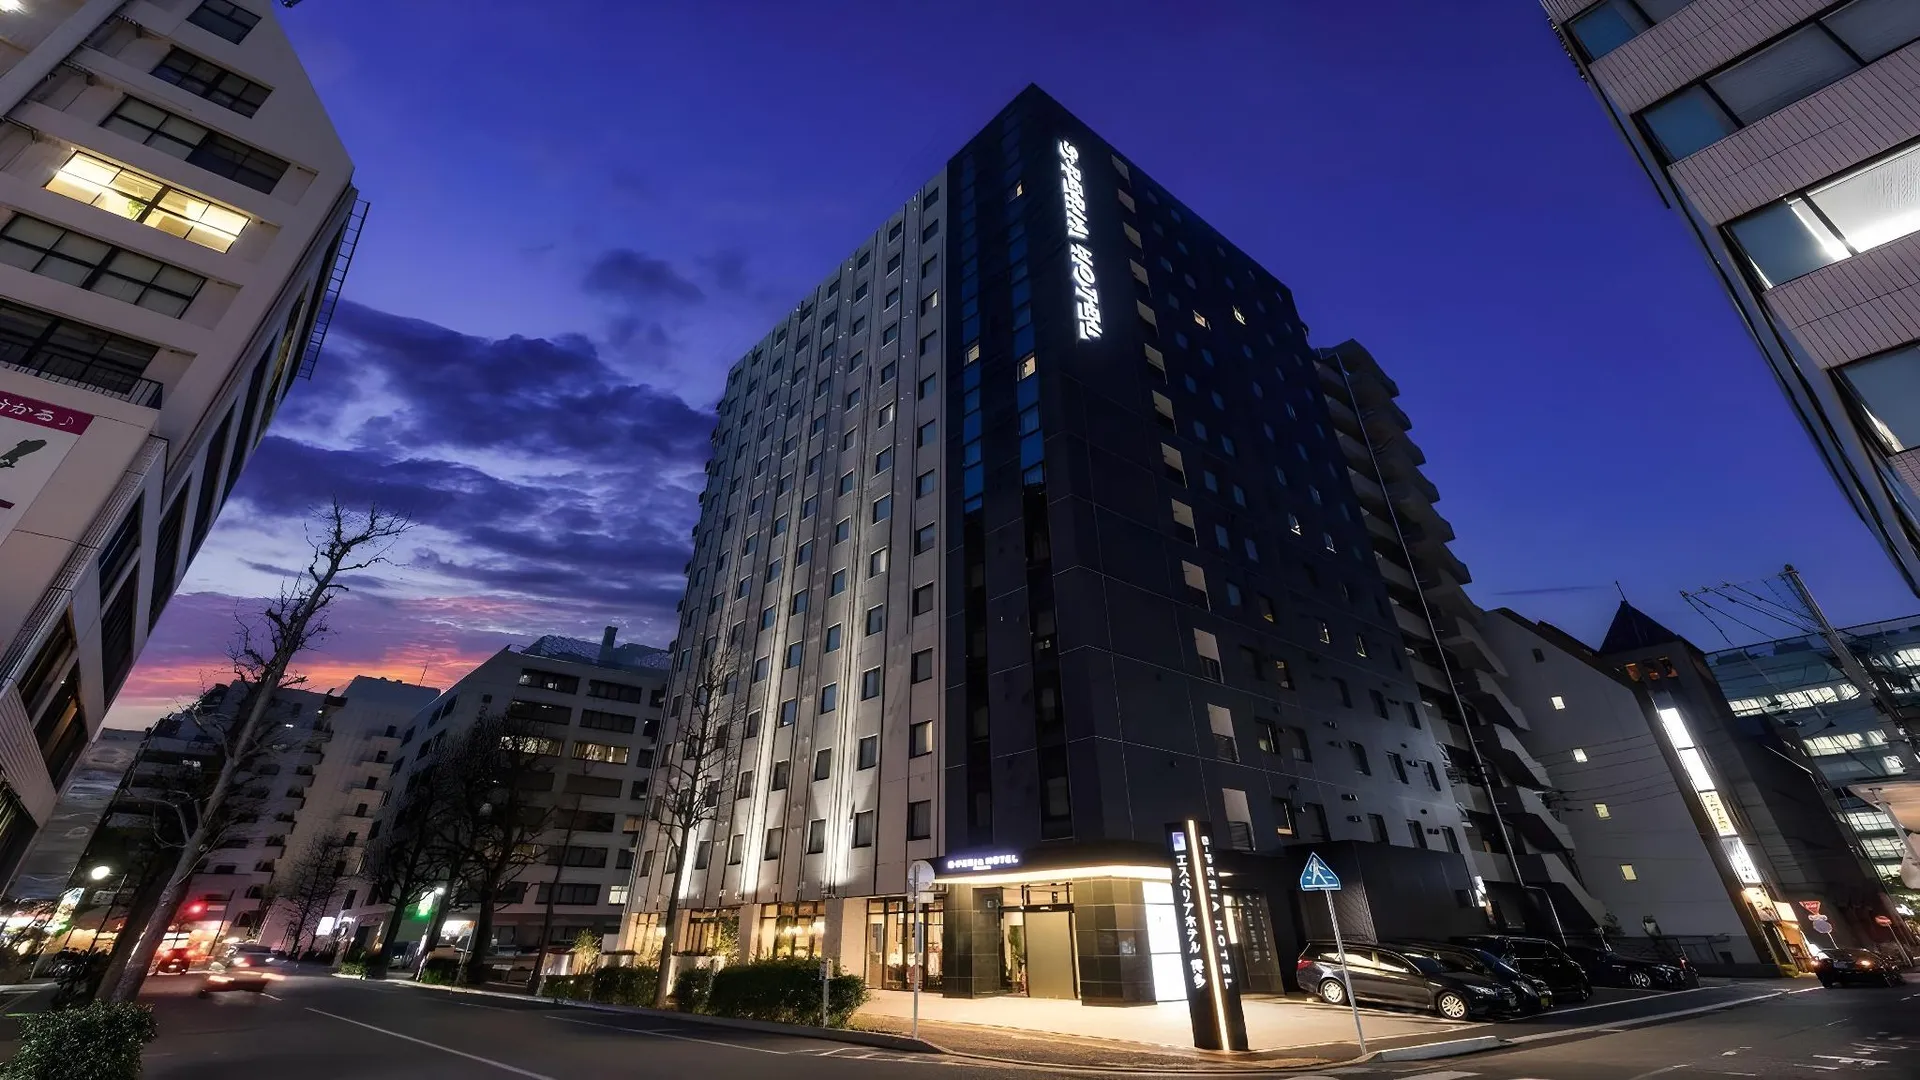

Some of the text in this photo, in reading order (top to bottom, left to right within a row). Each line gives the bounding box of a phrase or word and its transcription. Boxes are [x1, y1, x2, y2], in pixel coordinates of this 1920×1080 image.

[1070, 243, 1103, 340] HOTEL
[1176, 855, 1200, 954] エスペリアホテル
[1215, 920, 1232, 989] HOTEL
